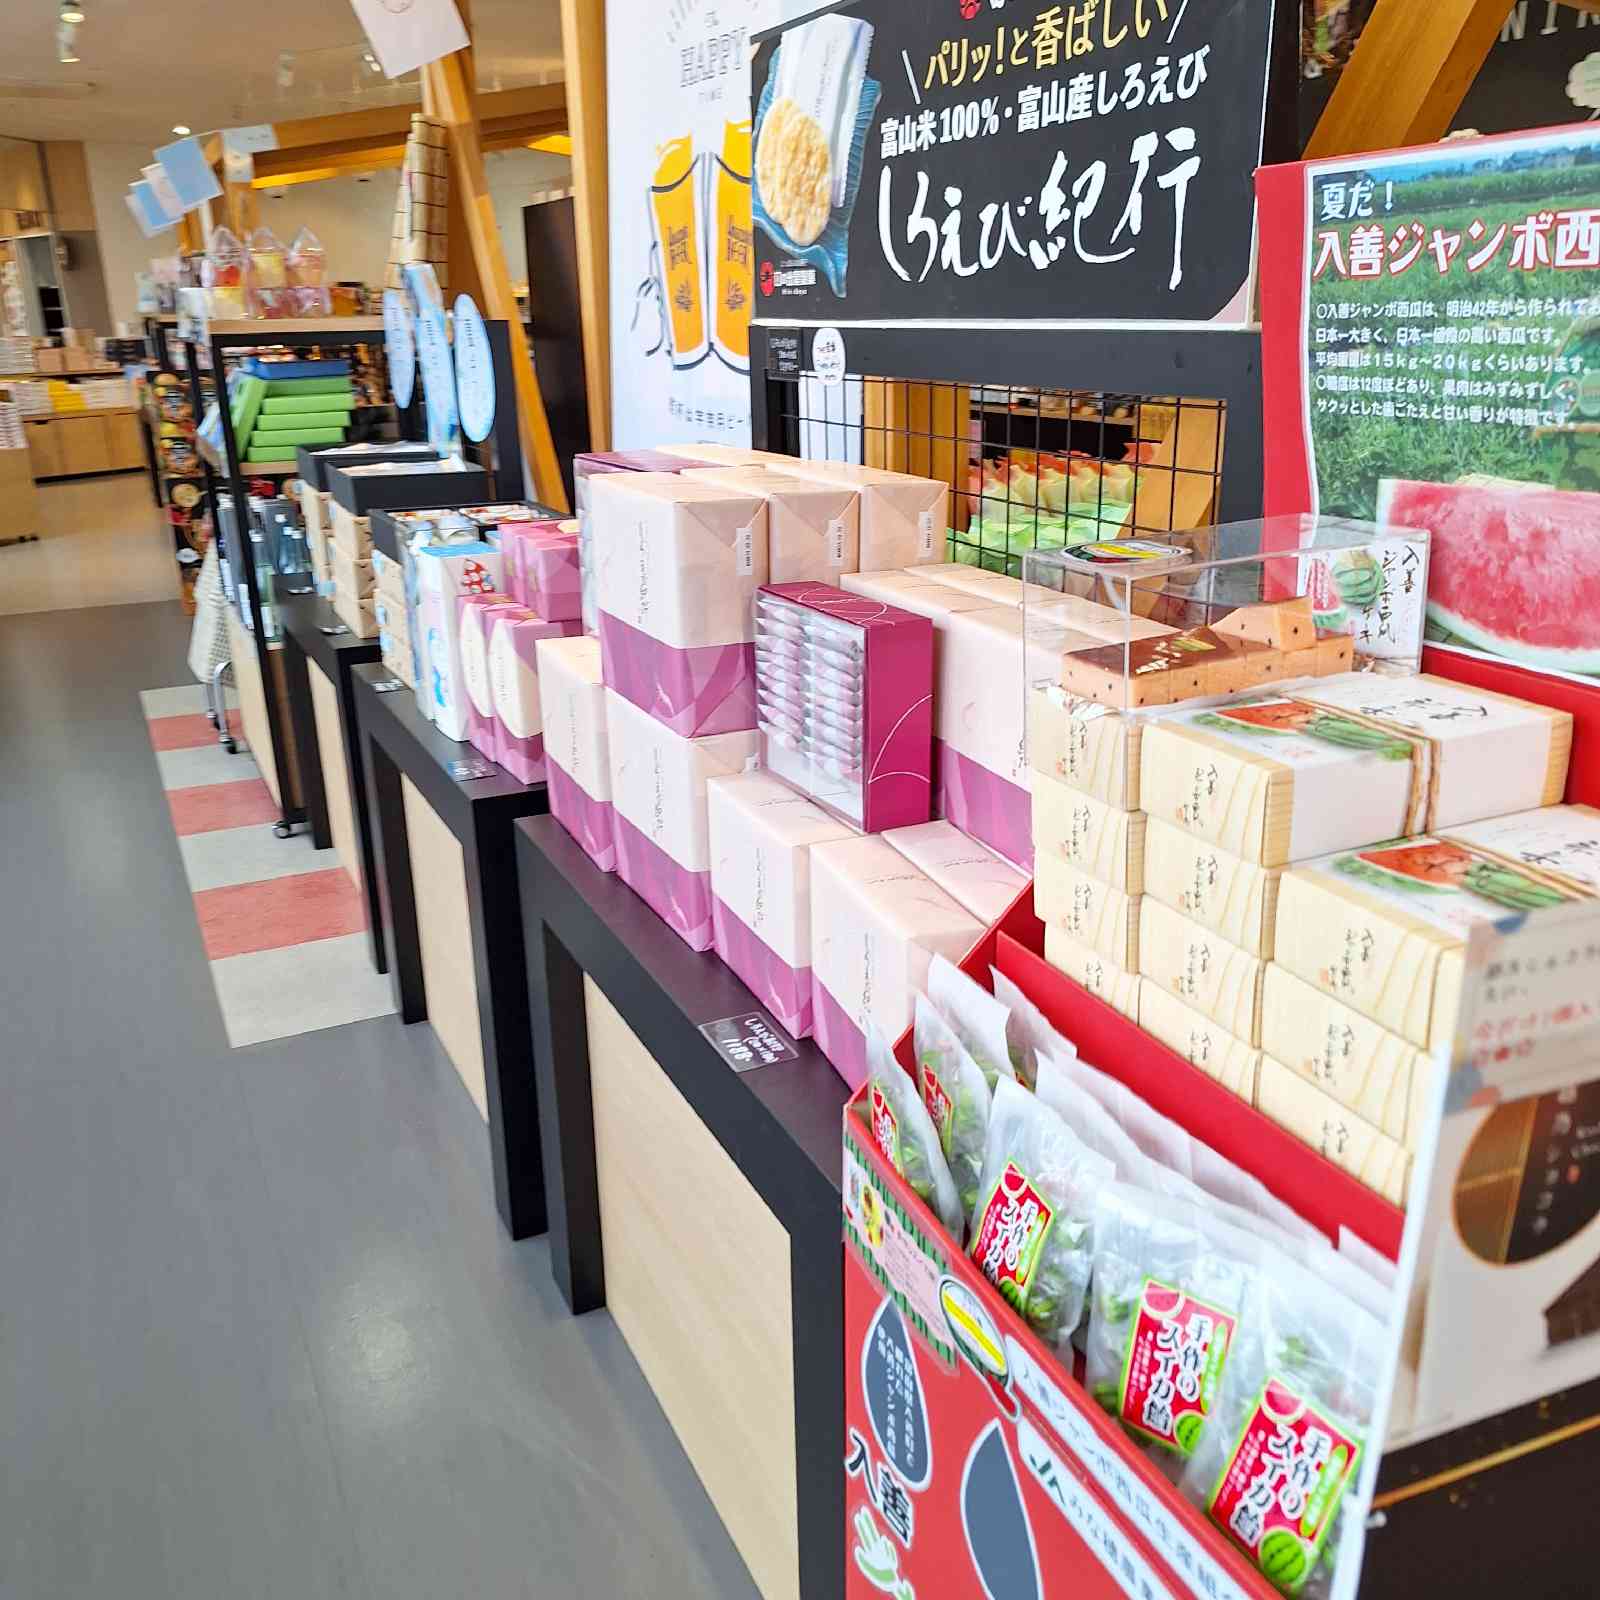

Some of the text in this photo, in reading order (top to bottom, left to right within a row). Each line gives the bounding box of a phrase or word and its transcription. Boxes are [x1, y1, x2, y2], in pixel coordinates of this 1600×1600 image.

[880, 44, 1210, 159] 富山米100%・富山産しろえび
[1321, 180, 1394, 221] 夏だ！
[1180, 1317, 1210, 1398] 手作の
[1283, 1431, 1329, 1514] 手作の
